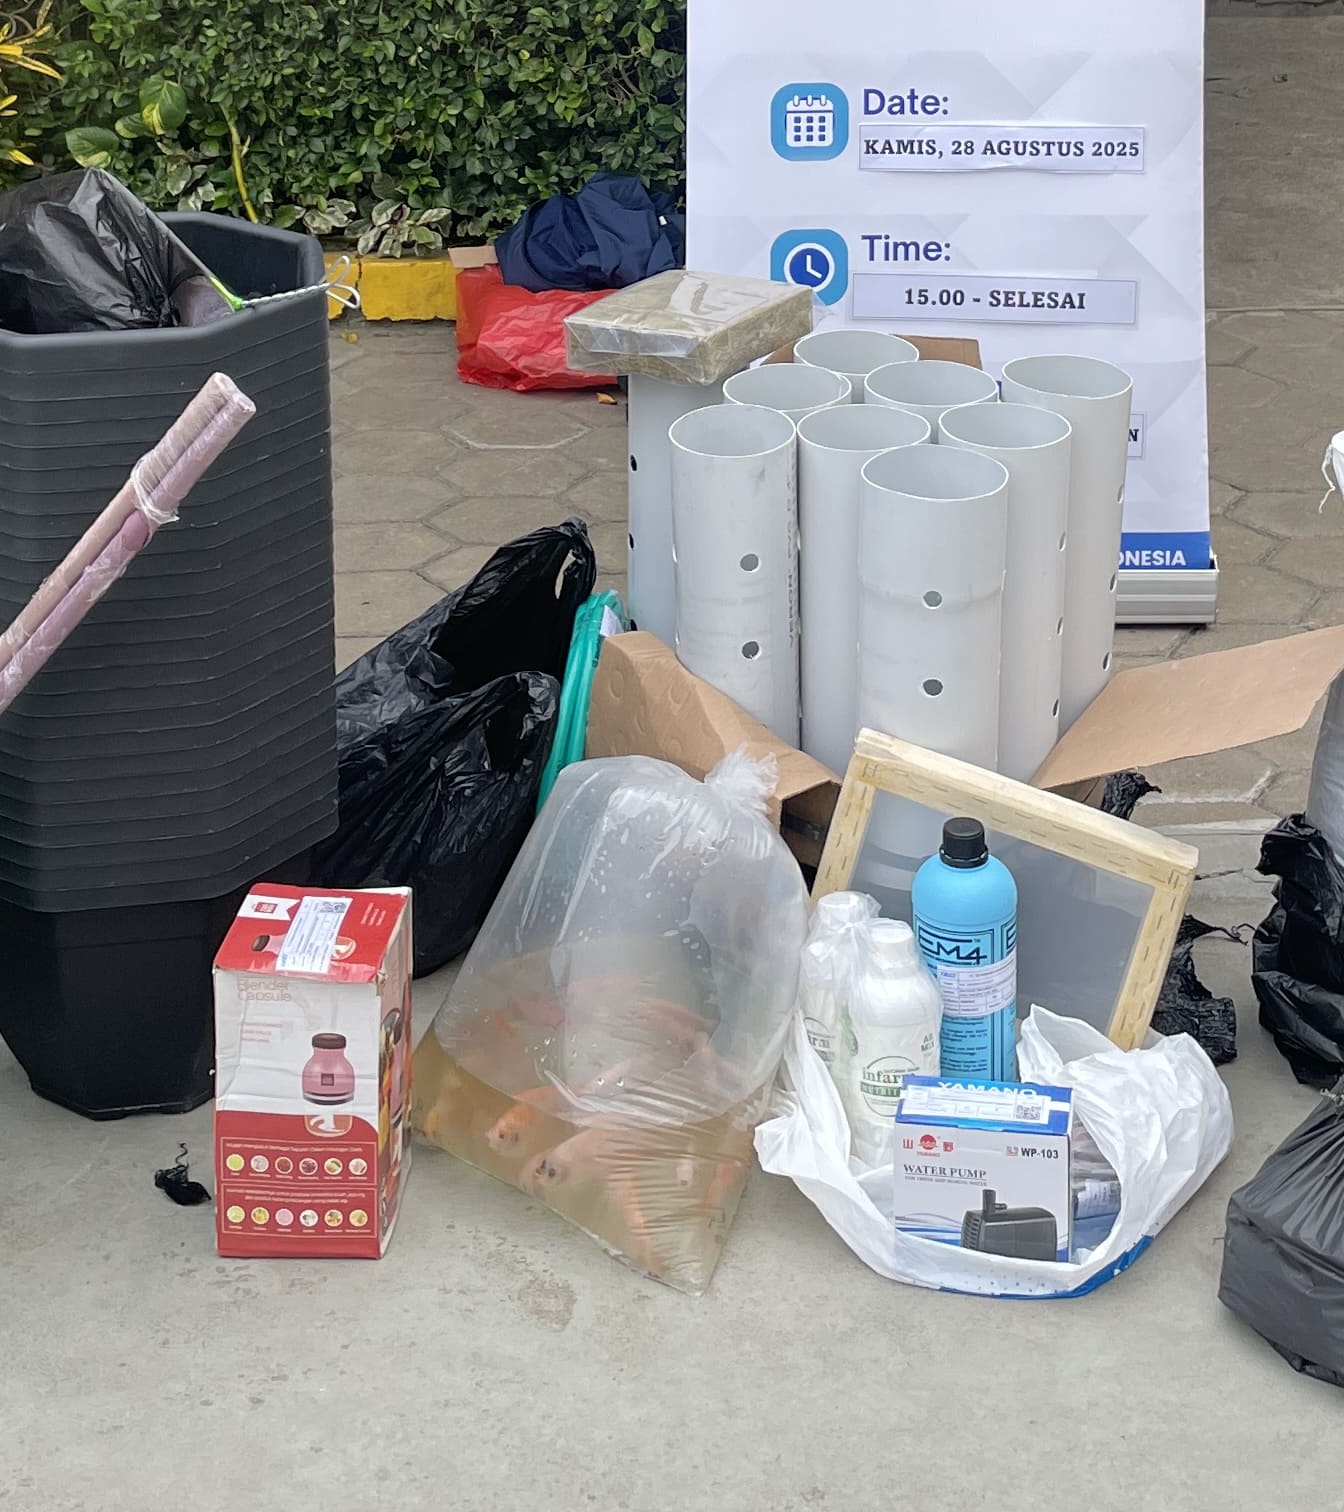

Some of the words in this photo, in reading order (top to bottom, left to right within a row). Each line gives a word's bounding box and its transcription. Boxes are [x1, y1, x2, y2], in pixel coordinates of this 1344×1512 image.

[863, 88, 949, 115] Date:
[863, 140, 943, 159] KAMIS,
[951, 140, 975, 156] 28
[981, 141, 1085, 157] AGUSTUS
[1091, 141, 1140, 158] 2025
[861, 235, 952, 262] Time:
[904, 288, 965, 307] 15.00
[988, 291, 1086, 311] SELESAI
[1119, 550, 1187, 567] NESIA
[918, 925, 987, 965] EM4
[1021, 1147, 1059, 1160] WP-103
[903, 1164, 947, 1176] WATER
[950, 1168, 987, 1179] PUMP
